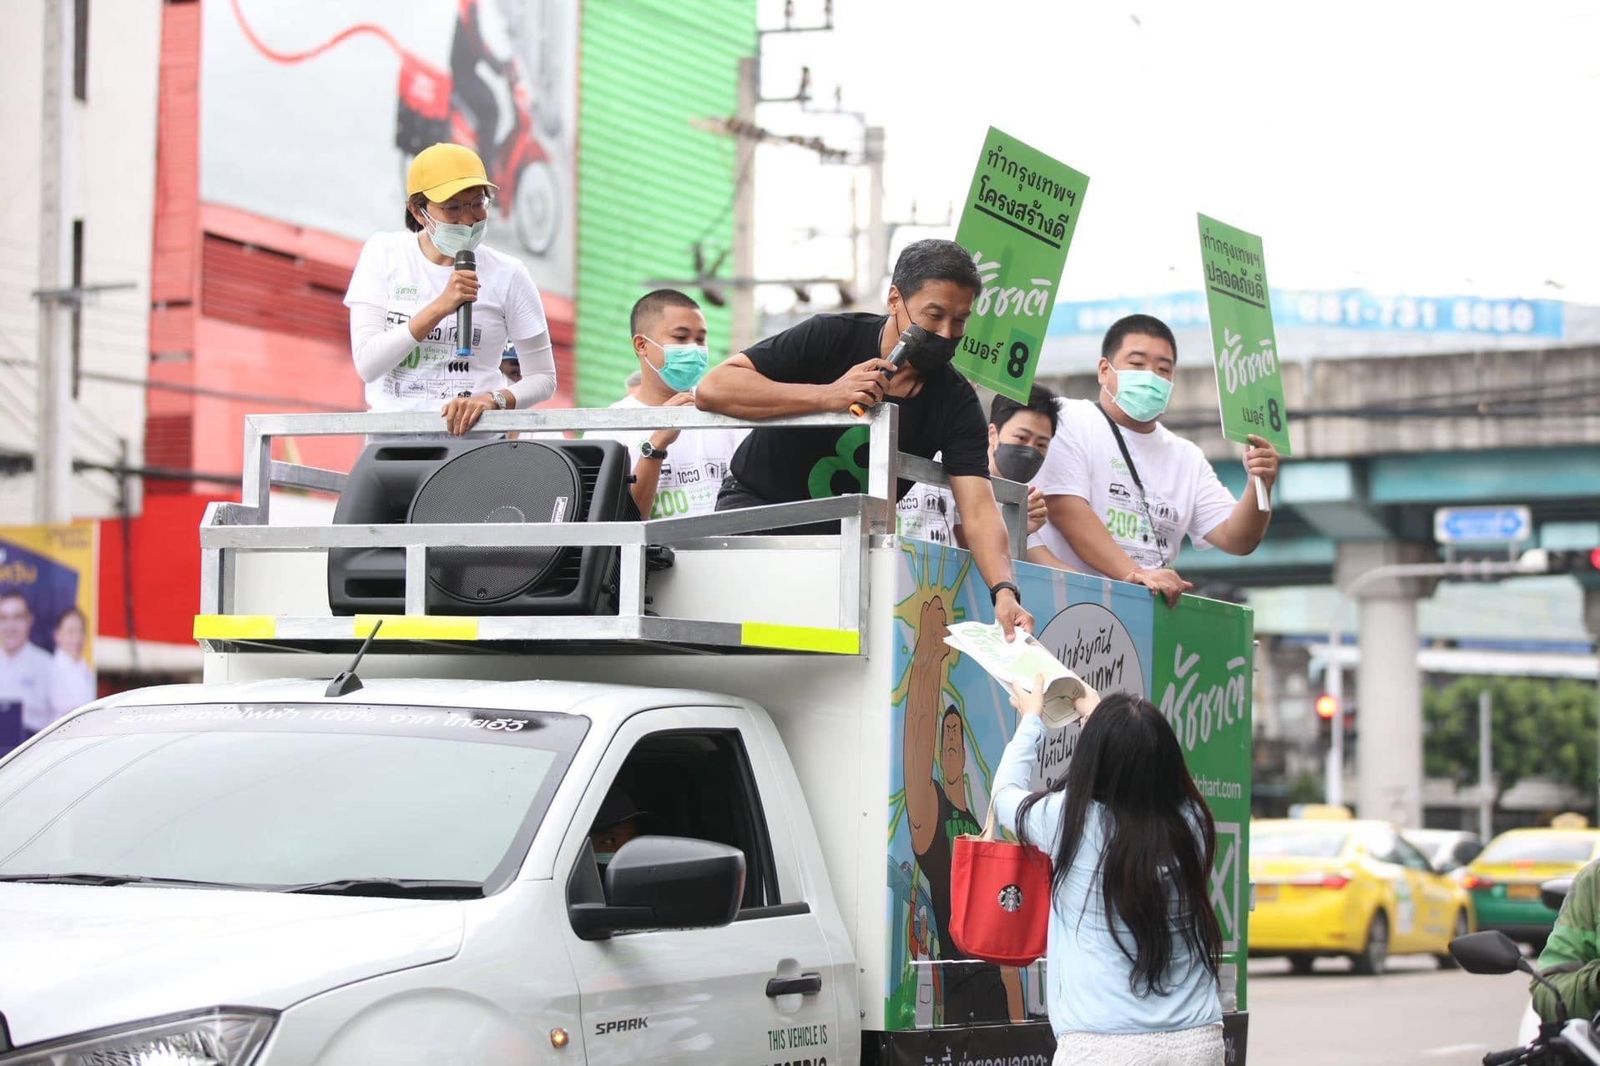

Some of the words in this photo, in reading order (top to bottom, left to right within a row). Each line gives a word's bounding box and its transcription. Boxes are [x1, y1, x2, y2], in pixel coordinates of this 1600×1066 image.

[987, 146, 1076, 207] ทำกรุงเทพฯ
[978, 176, 1069, 240] โครงสร้างดี
[1203, 227, 1261, 268] ทำกรุงเทพฯ
[1206, 260, 1264, 300] ปลอดภัยดี
[962, 336, 1004, 364] เบอร์
[1006, 341, 1029, 379] 8
[1218, 327, 1275, 394] ชัชชาติ
[1242, 406, 1265, 428] เบอร์
[1268, 398, 1282, 432] 8
[1106, 507, 1138, 539] 200
[310, 709, 377, 722] 100%
[388, 710, 435, 725] จาก
[443, 712, 529, 732] ไทยอีวี
[595, 1016, 649, 1036] SPARK
[768, 1029, 785, 1051] THIS
[787, 1025, 818, 1049] VEHICLE
[819, 1024, 828, 1045] IS
